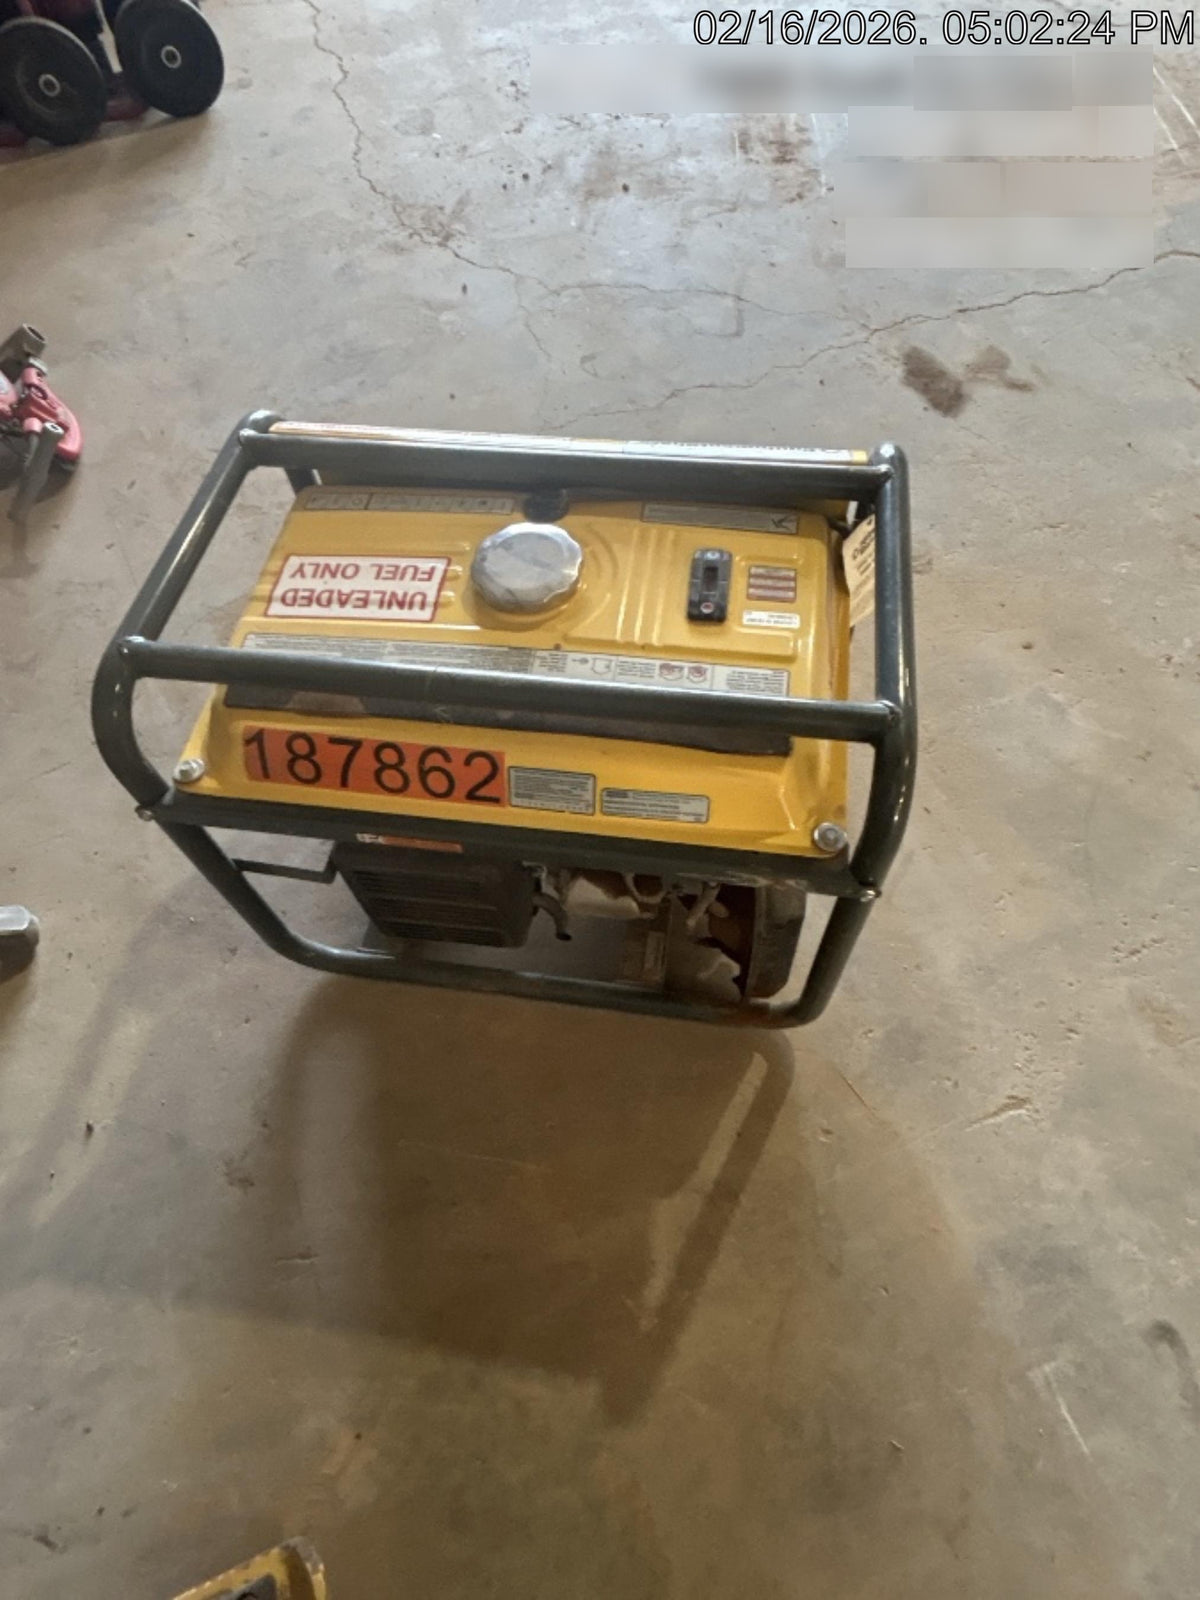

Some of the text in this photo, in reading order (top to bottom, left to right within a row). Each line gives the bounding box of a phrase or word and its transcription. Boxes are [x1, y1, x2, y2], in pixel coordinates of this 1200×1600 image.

[289, 560, 436, 582] FUEL ONLY
[281, 589, 427, 610] UNLEADED
[243, 728, 502, 803] 187862
